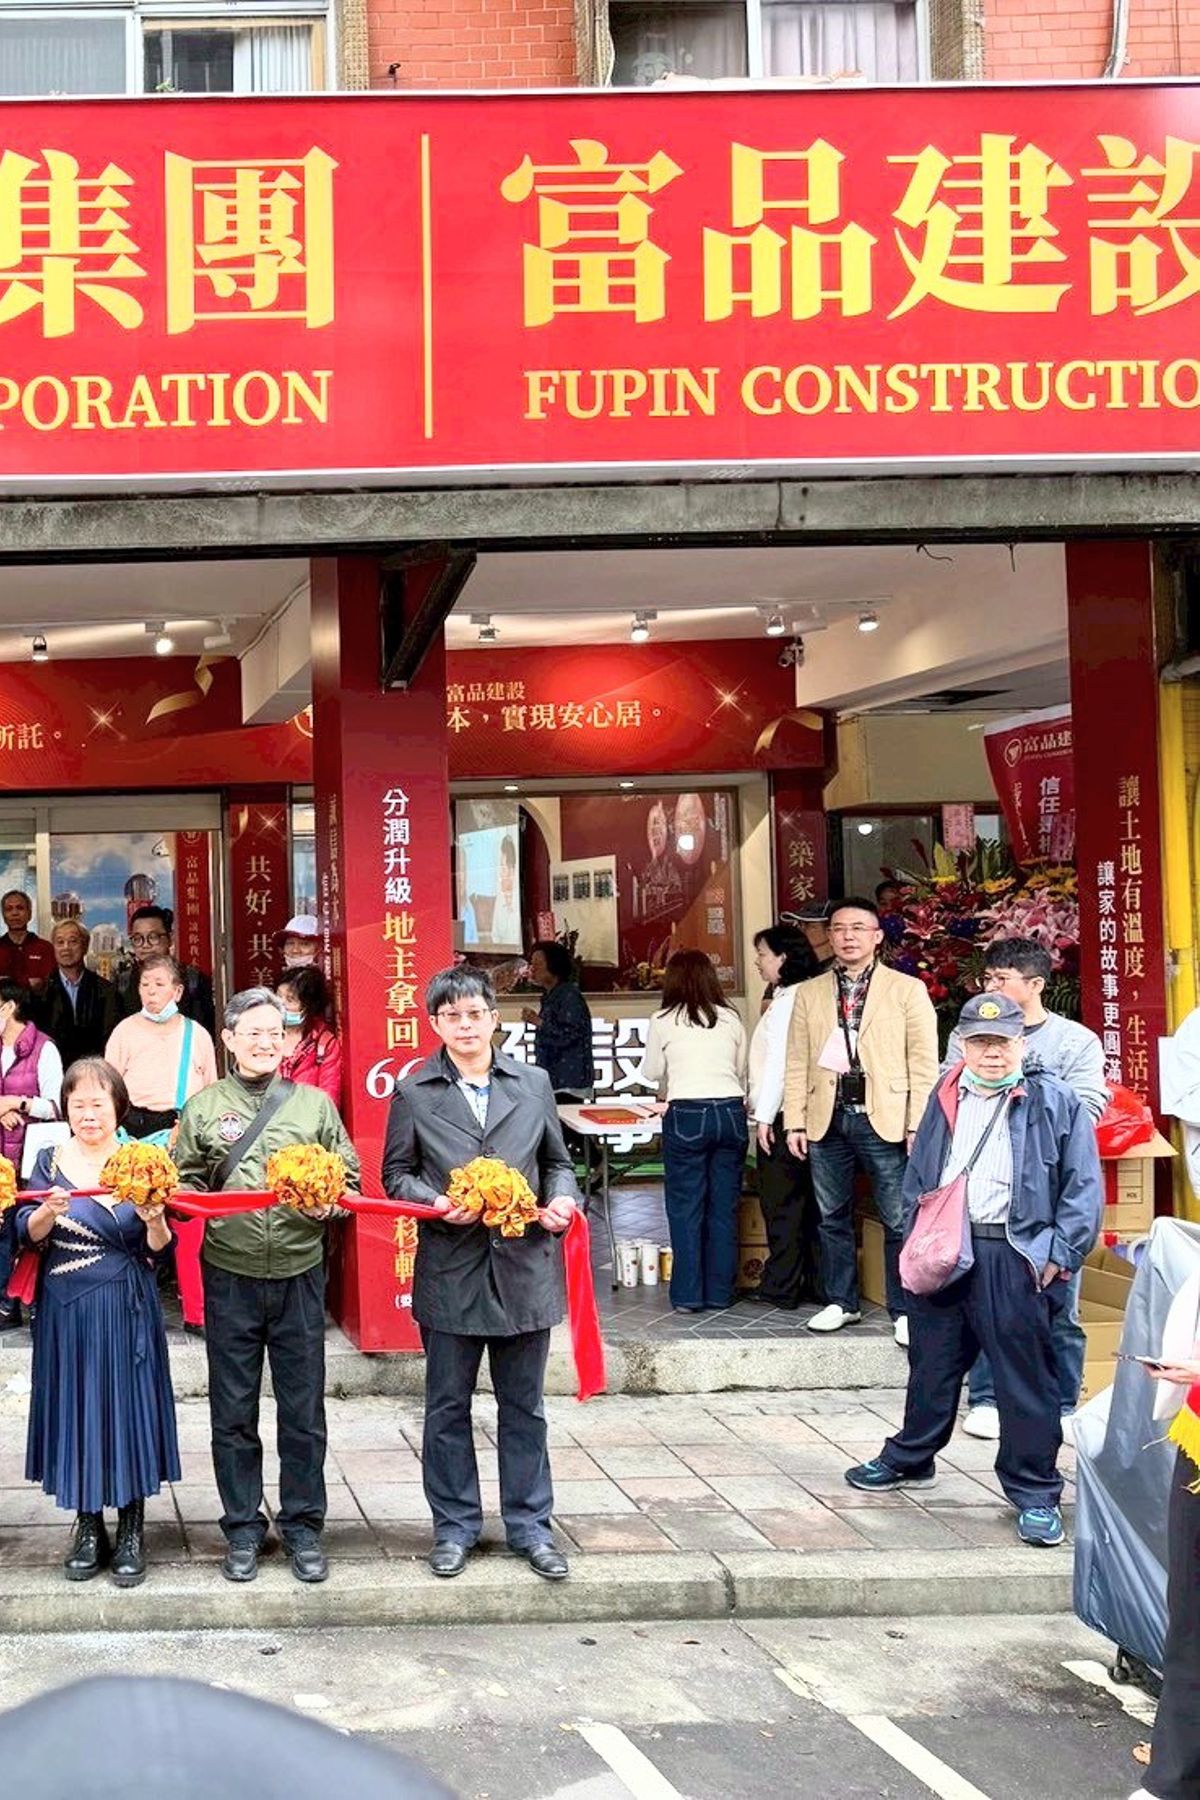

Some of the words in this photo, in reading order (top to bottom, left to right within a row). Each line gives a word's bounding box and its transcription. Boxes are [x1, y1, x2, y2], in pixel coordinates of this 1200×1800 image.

[501, 132, 1200, 327] 富品建設
[523, 366, 720, 420] FUPIN
[741, 360, 1200, 416] CONSTRUCTIO
[446, 681, 526, 703] 富品建設
[382, 788, 412, 905] 分潤升級
[382, 911, 420, 1052] 地主拿回
